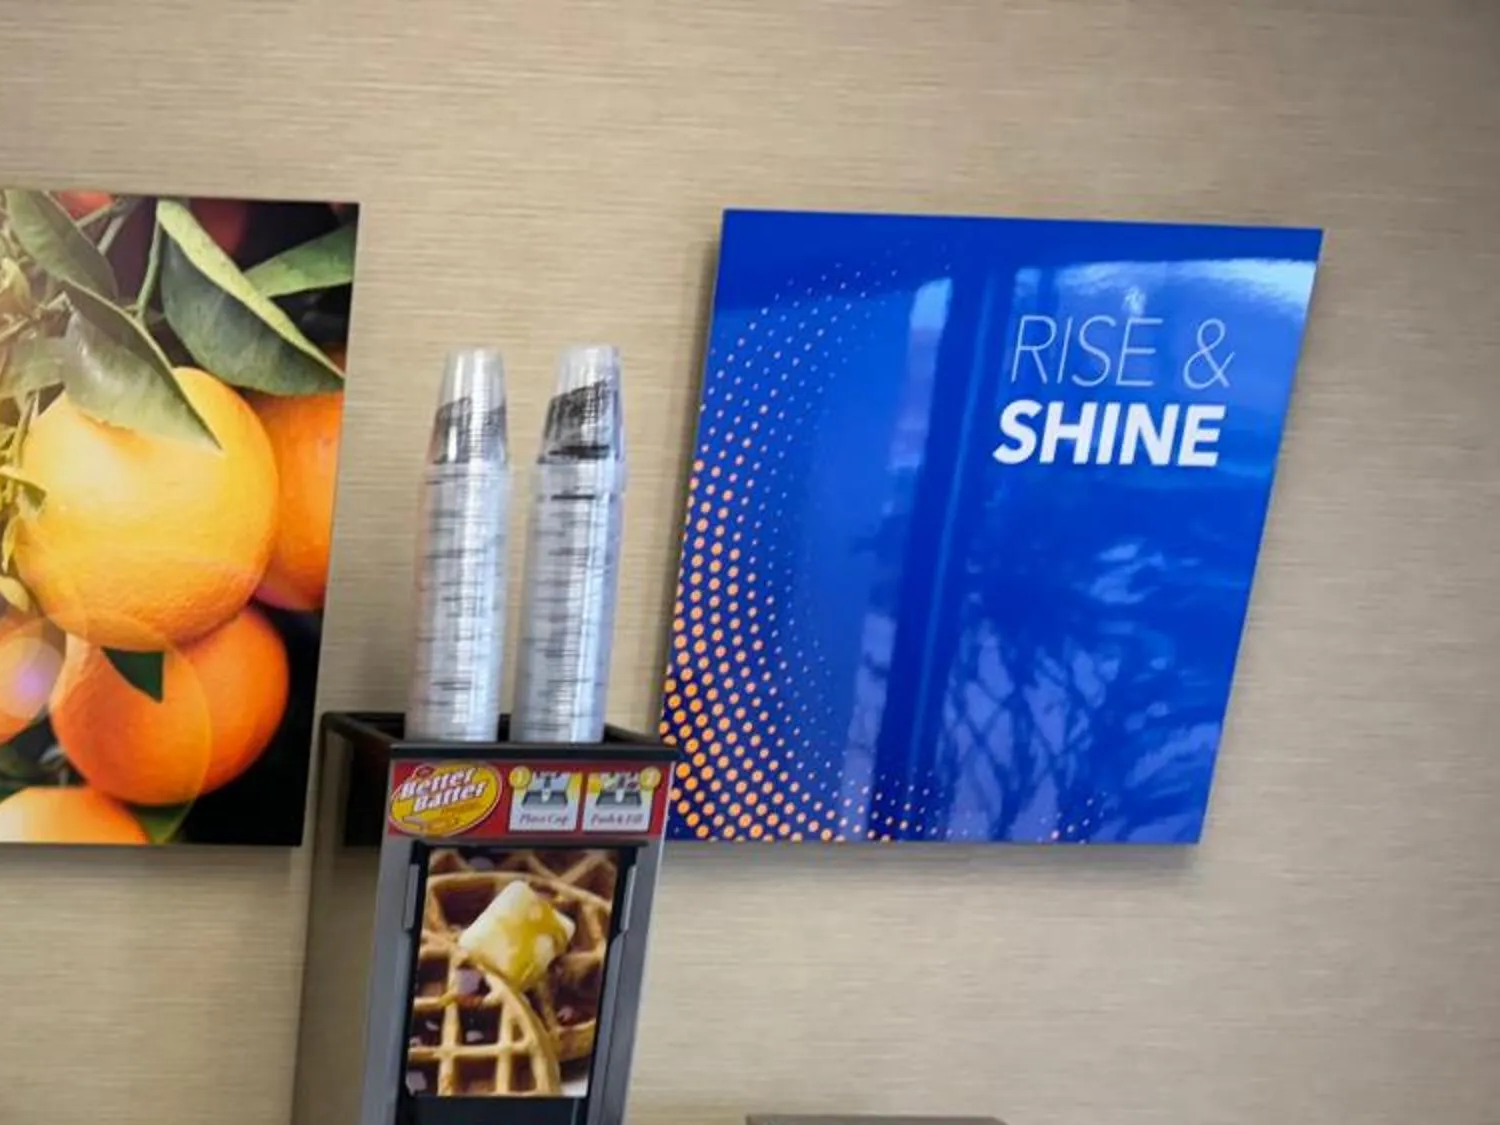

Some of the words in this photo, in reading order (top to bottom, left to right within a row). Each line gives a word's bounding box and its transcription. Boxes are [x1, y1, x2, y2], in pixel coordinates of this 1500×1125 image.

[1010, 314, 1164, 387] RISE
[1183, 317, 1236, 390] &
[992, 398, 1227, 467] SHINE
